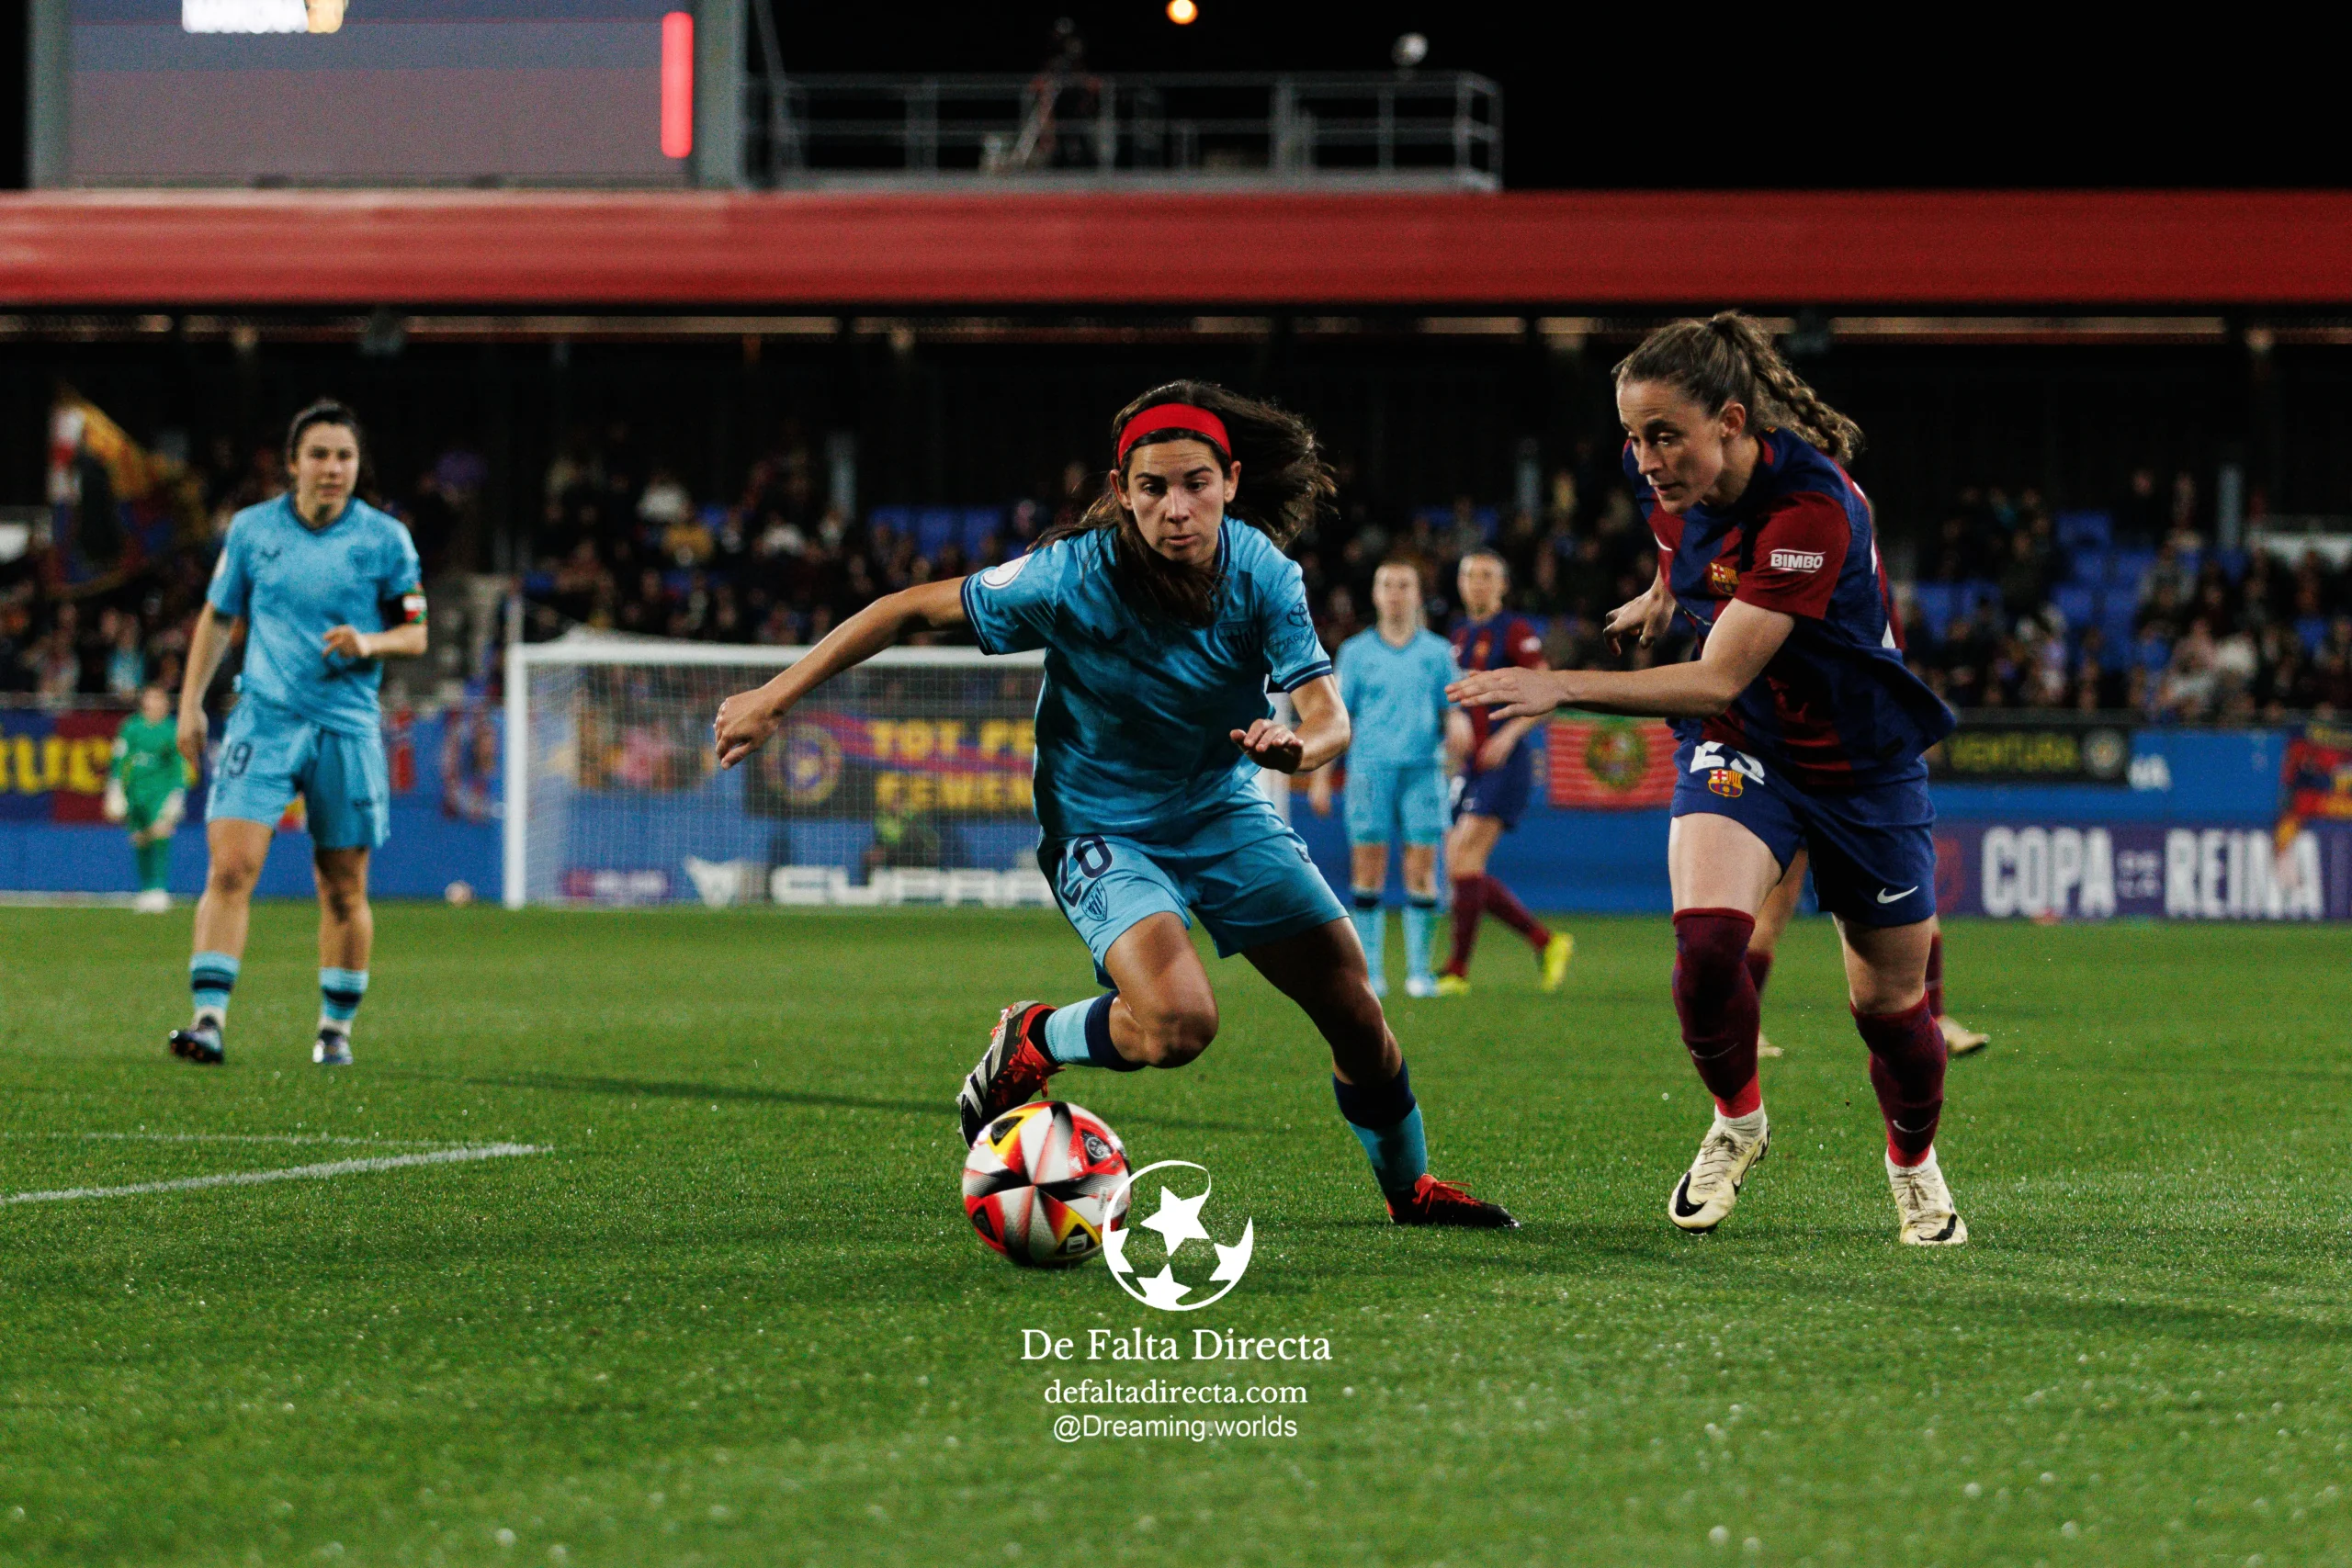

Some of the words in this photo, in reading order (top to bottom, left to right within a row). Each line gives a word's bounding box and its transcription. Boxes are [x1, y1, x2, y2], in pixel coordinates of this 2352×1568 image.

[1770, 553, 1824, 569] BIMBO
[770, 864, 1057, 908] CUPRA
[1057, 834, 1114, 908] 20
[1982, 826, 2117, 919] COPA
[2165, 829, 2324, 919] REINA
